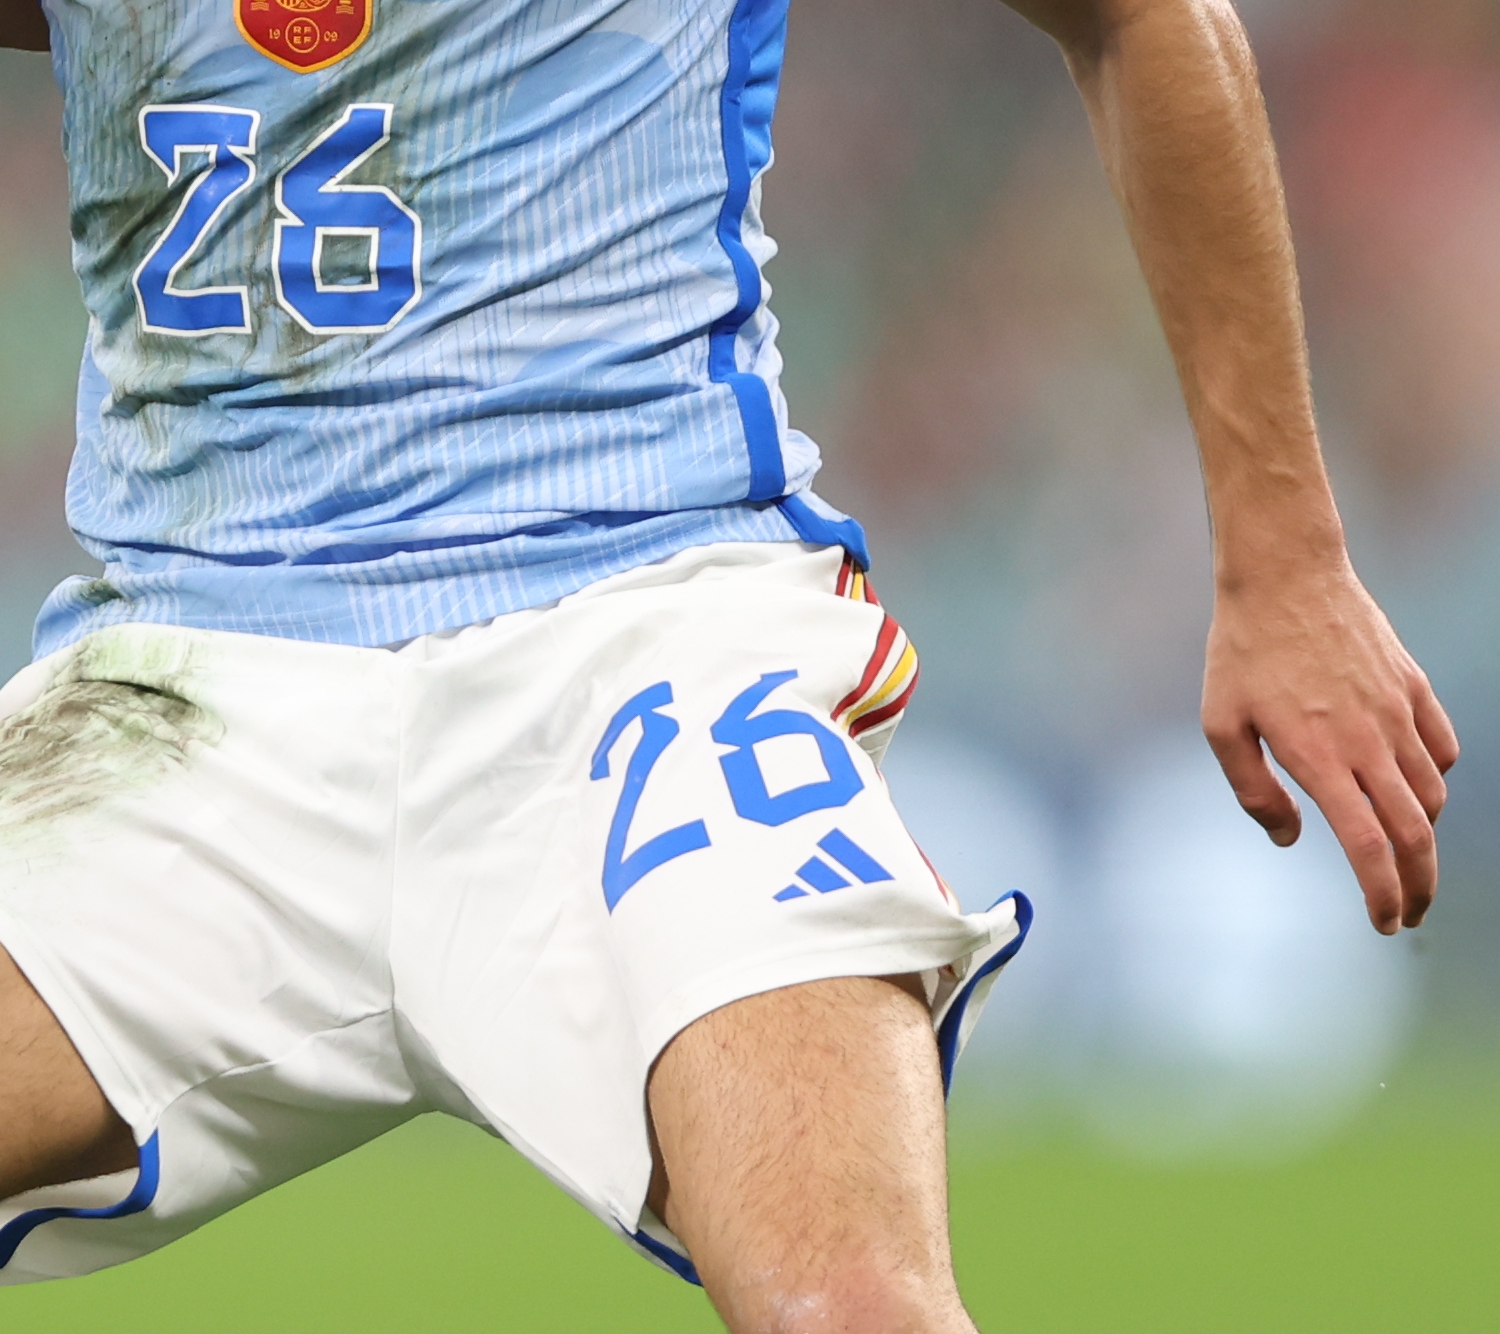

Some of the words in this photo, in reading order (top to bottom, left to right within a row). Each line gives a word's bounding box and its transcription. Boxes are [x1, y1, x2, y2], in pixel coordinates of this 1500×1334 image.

[268, 28, 281, 40] 19
[323, 30, 339, 42] 09
[133, 103, 423, 336] 26
[590, 668, 866, 917] 26
